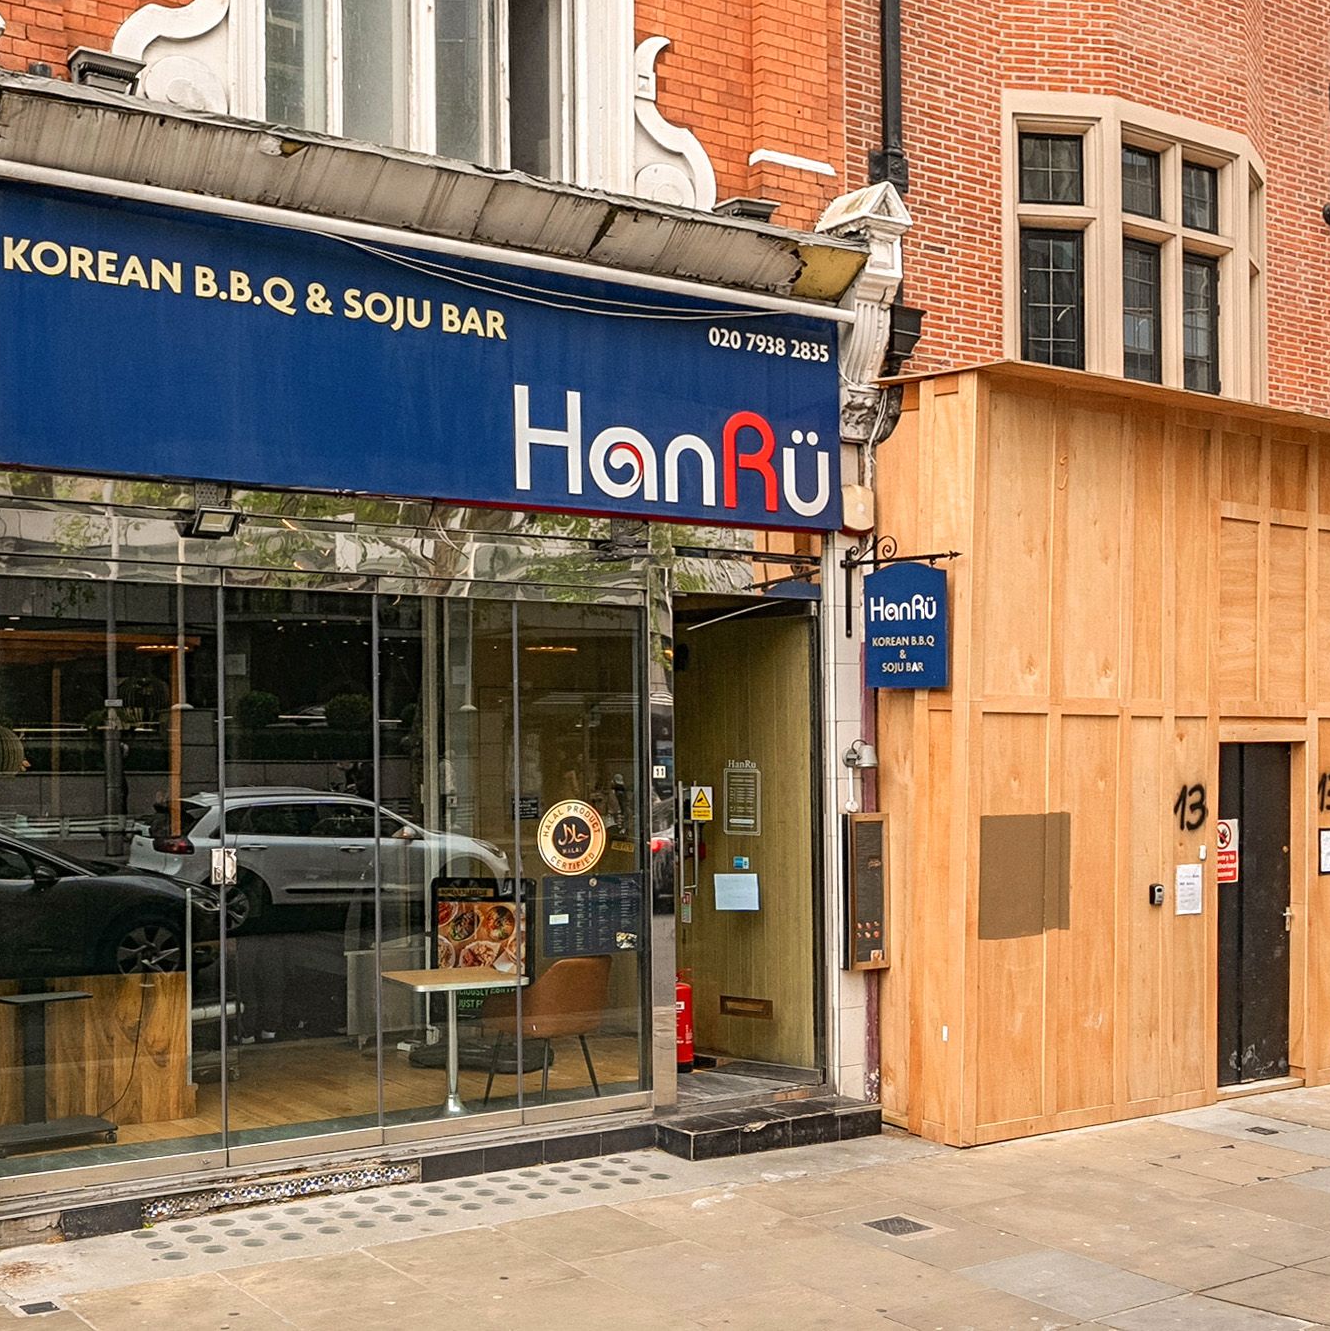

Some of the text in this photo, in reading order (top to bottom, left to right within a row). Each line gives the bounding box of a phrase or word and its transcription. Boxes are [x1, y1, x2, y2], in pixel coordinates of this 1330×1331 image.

[2, 236, 507, 340] KOREAN B.B.Q & SOJU BAR
[709, 327, 829, 363] 020 7938 2835
[514, 384, 829, 517] HanRü
[870, 594, 937, 621] HanRü
[872, 635, 934, 647] KOREAN B.B.Q
[899, 649, 907, 659] &
[882, 662, 924, 674] SOJU BAR
[543, 808, 564, 838] HALAL
[567, 805, 601, 834] PRODUCT
[1174, 784, 1208, 831] 13
[550, 851, 595, 870] CERTIFIED
